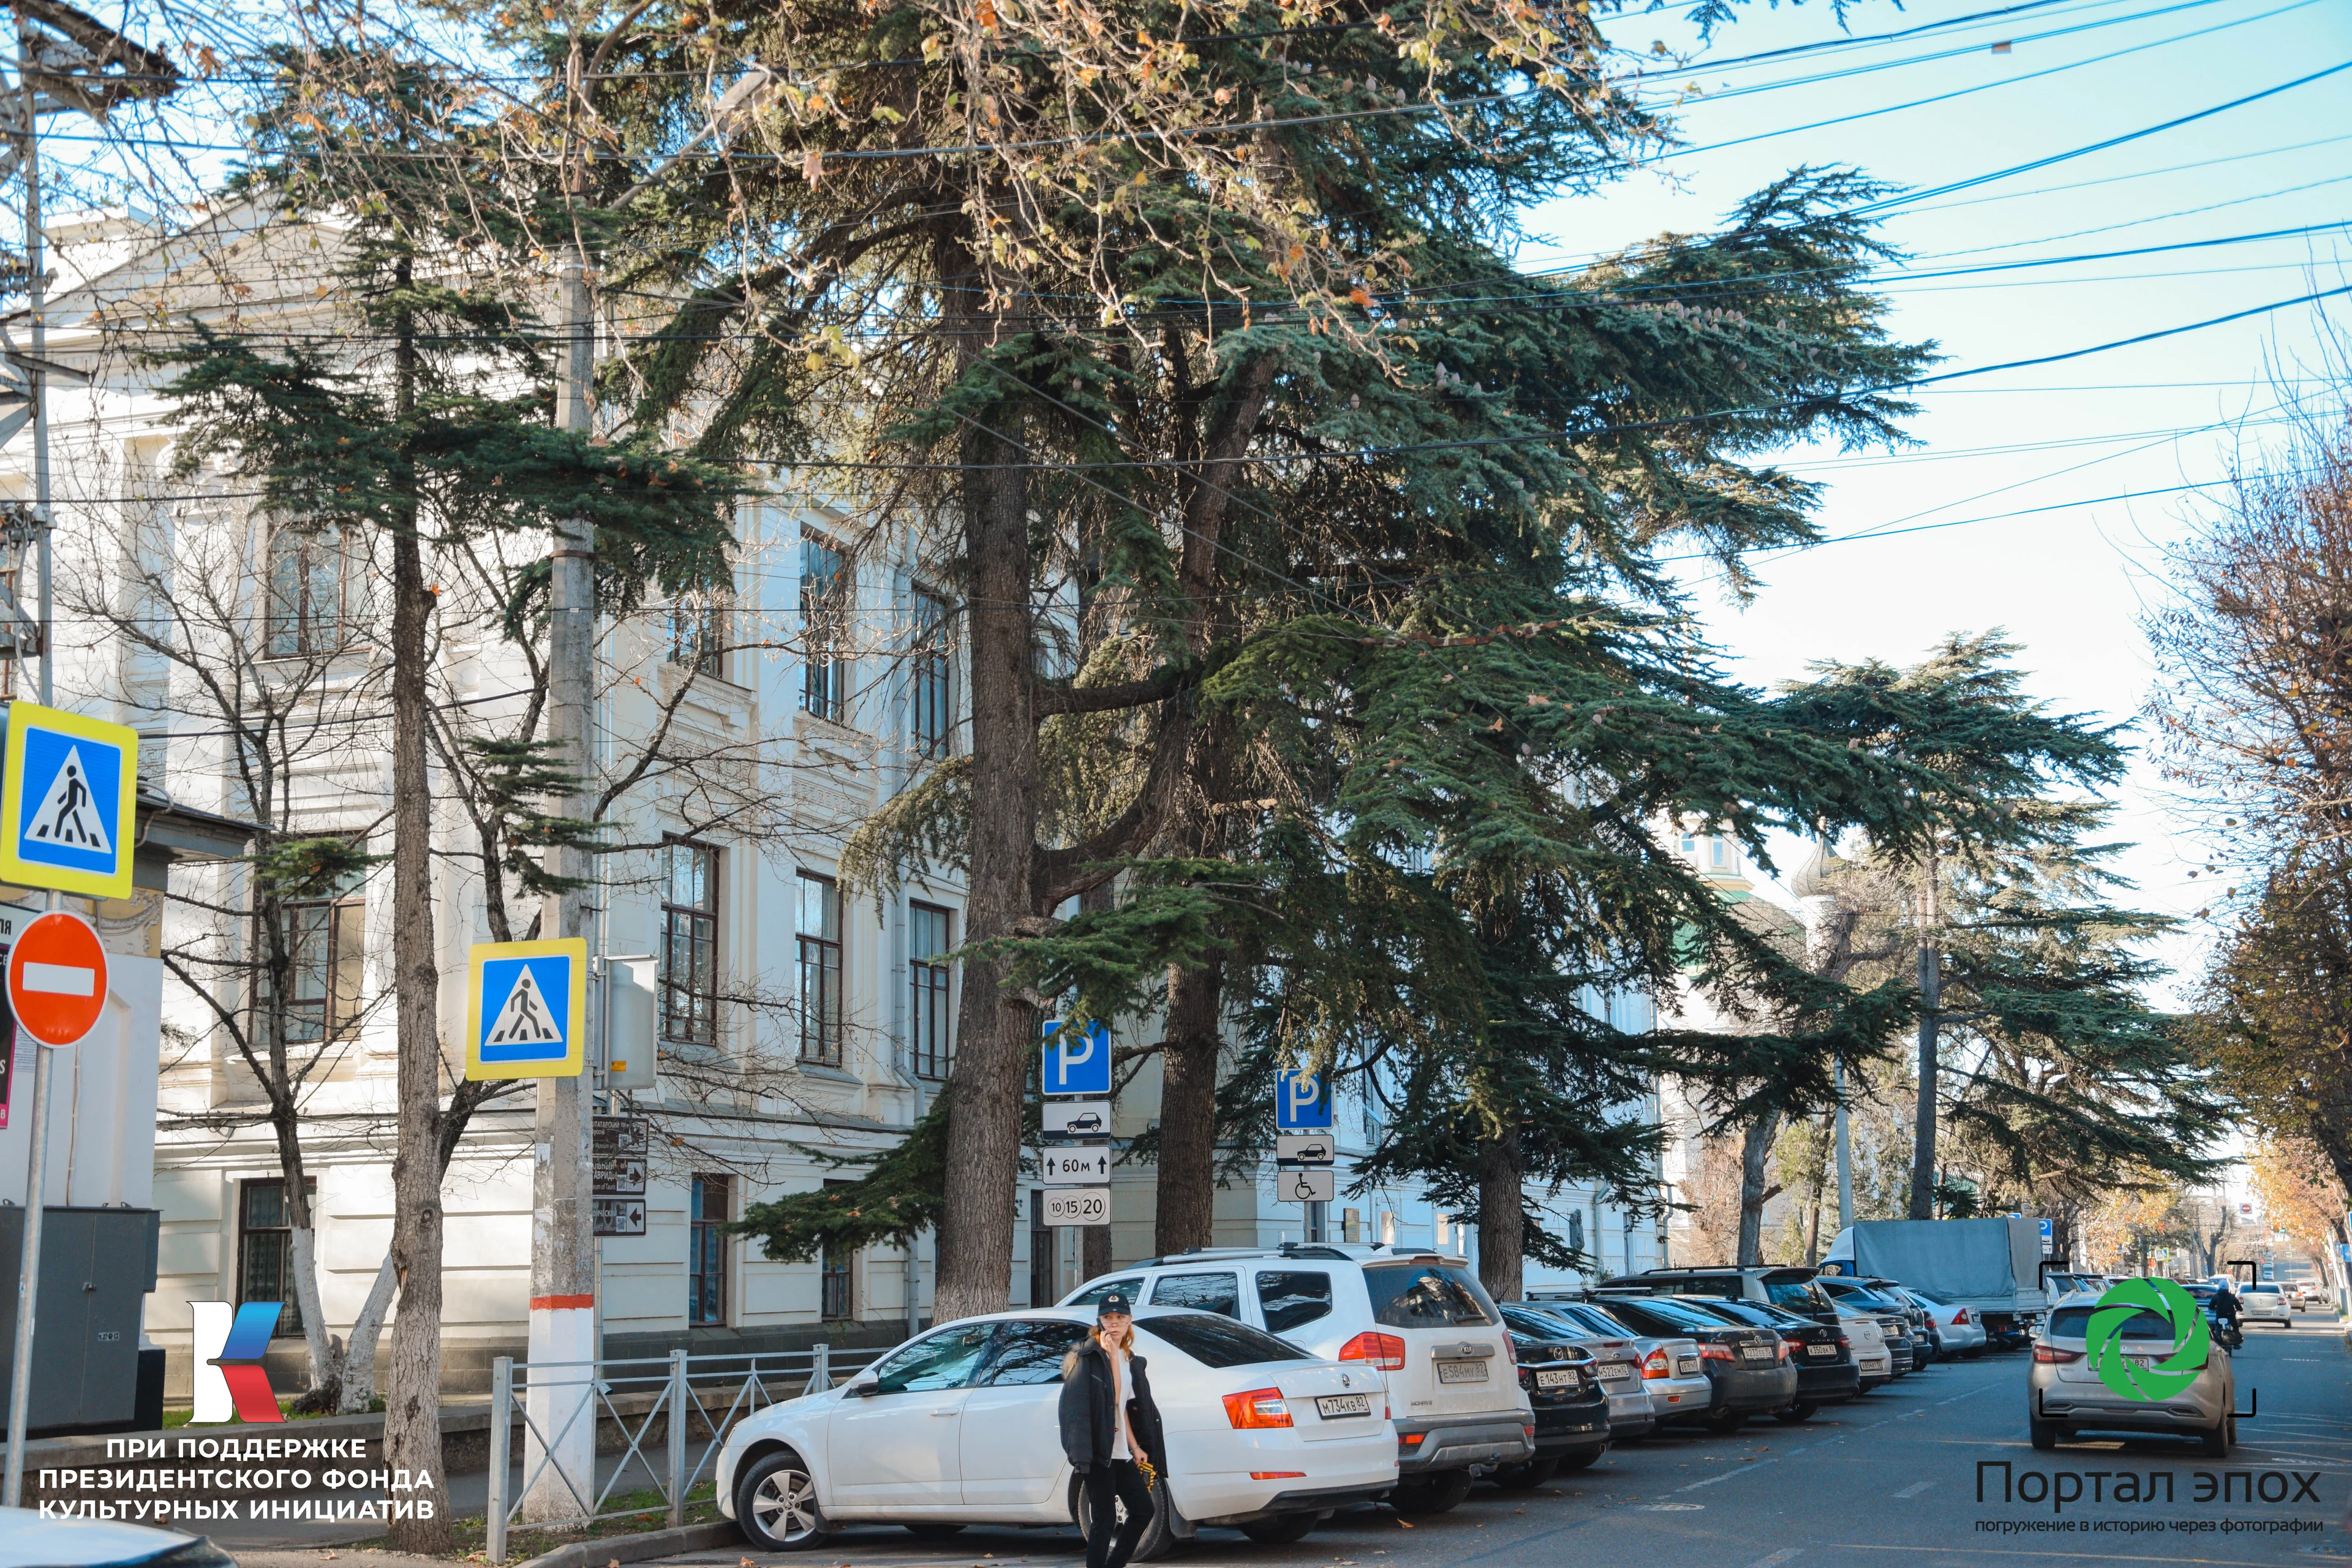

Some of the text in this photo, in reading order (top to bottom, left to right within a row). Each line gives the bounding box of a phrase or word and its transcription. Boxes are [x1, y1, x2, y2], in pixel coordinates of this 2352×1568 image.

[1052, 1199, 1102, 1214] 10 15 20
